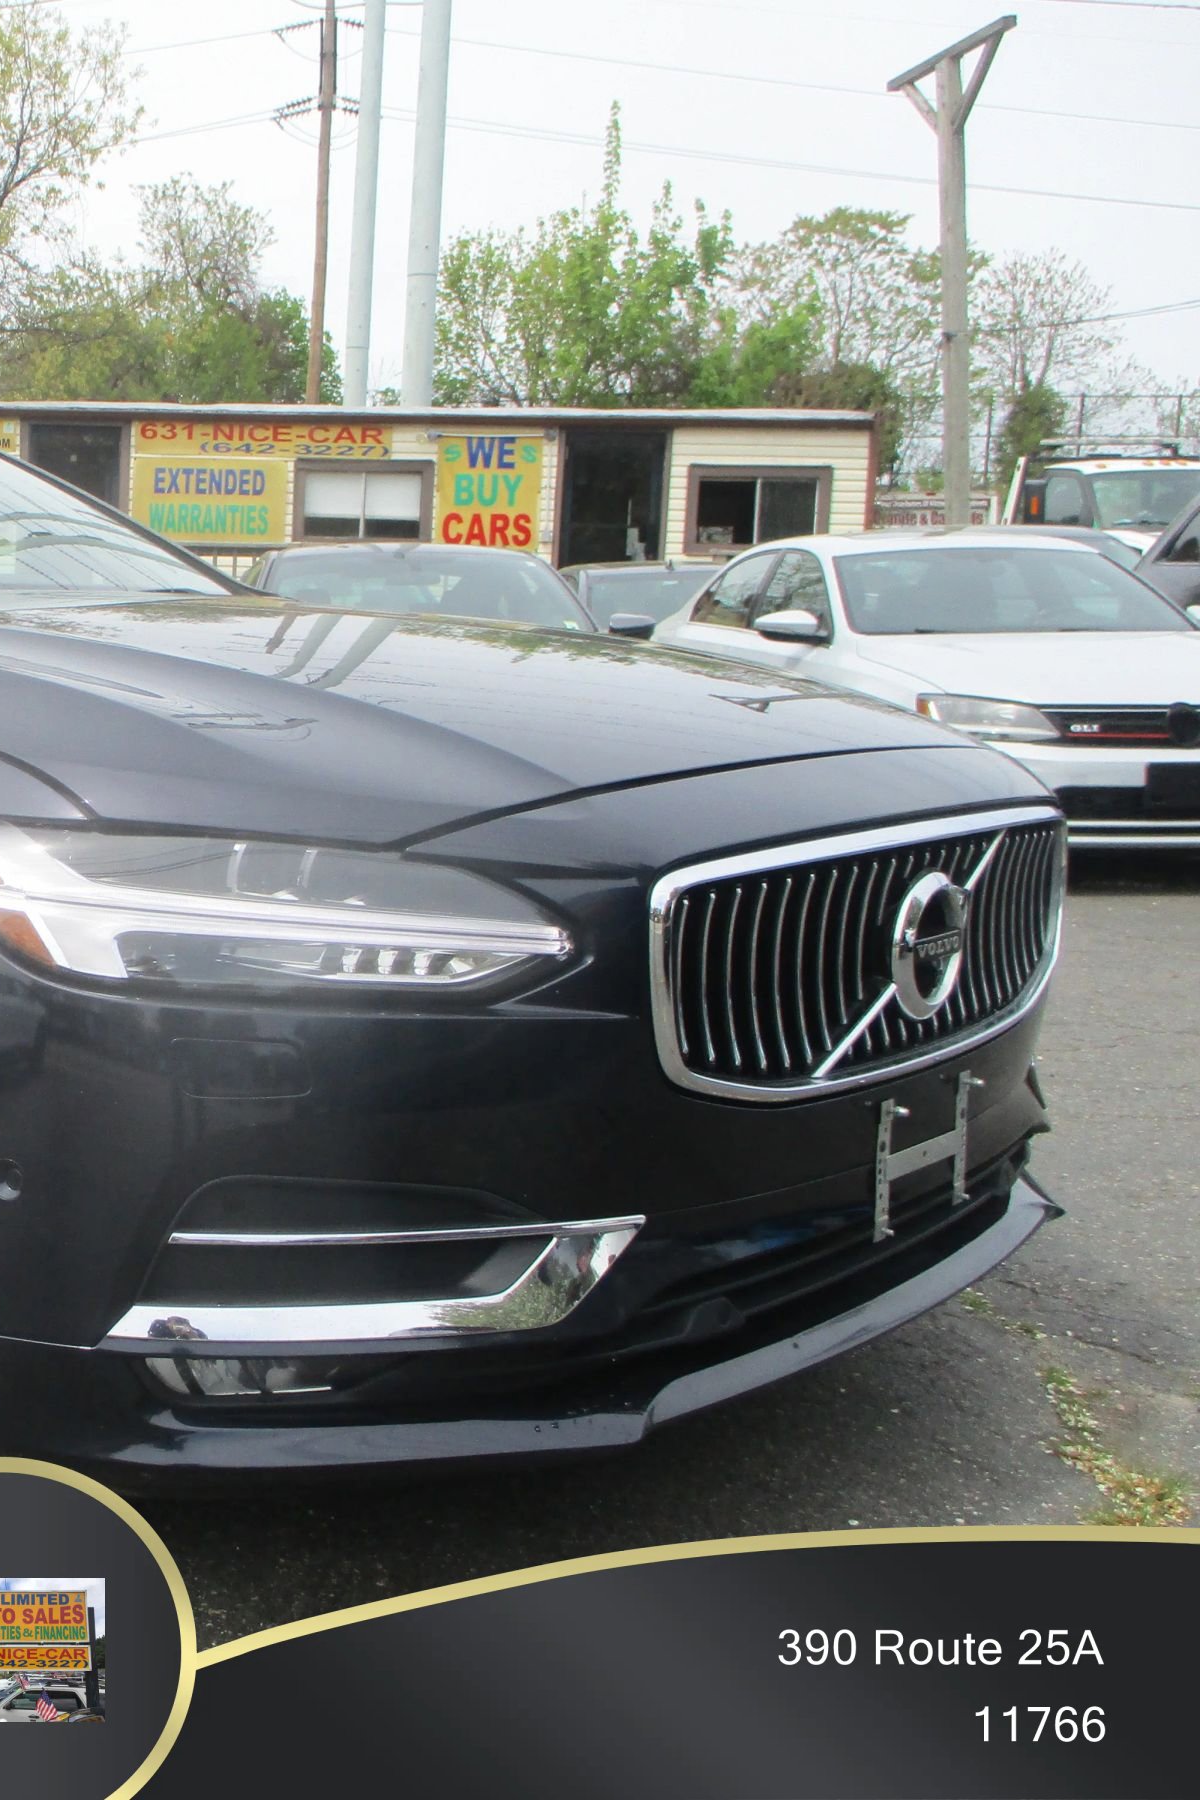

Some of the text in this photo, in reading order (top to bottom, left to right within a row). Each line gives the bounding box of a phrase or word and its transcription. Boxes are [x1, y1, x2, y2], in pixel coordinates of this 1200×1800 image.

[140, 422, 384, 444] 631-NICE-CAR
[199, 441, 390, 458] (642-3227)
[466, 436, 517, 469] WE
[153, 467, 266, 496] EXTENDED
[453, 473, 524, 507] BUY
[148, 502, 270, 536] WARRANTIES
[441, 512, 533, 547] CARS
[916, 935, 960, 959] VOLVO
